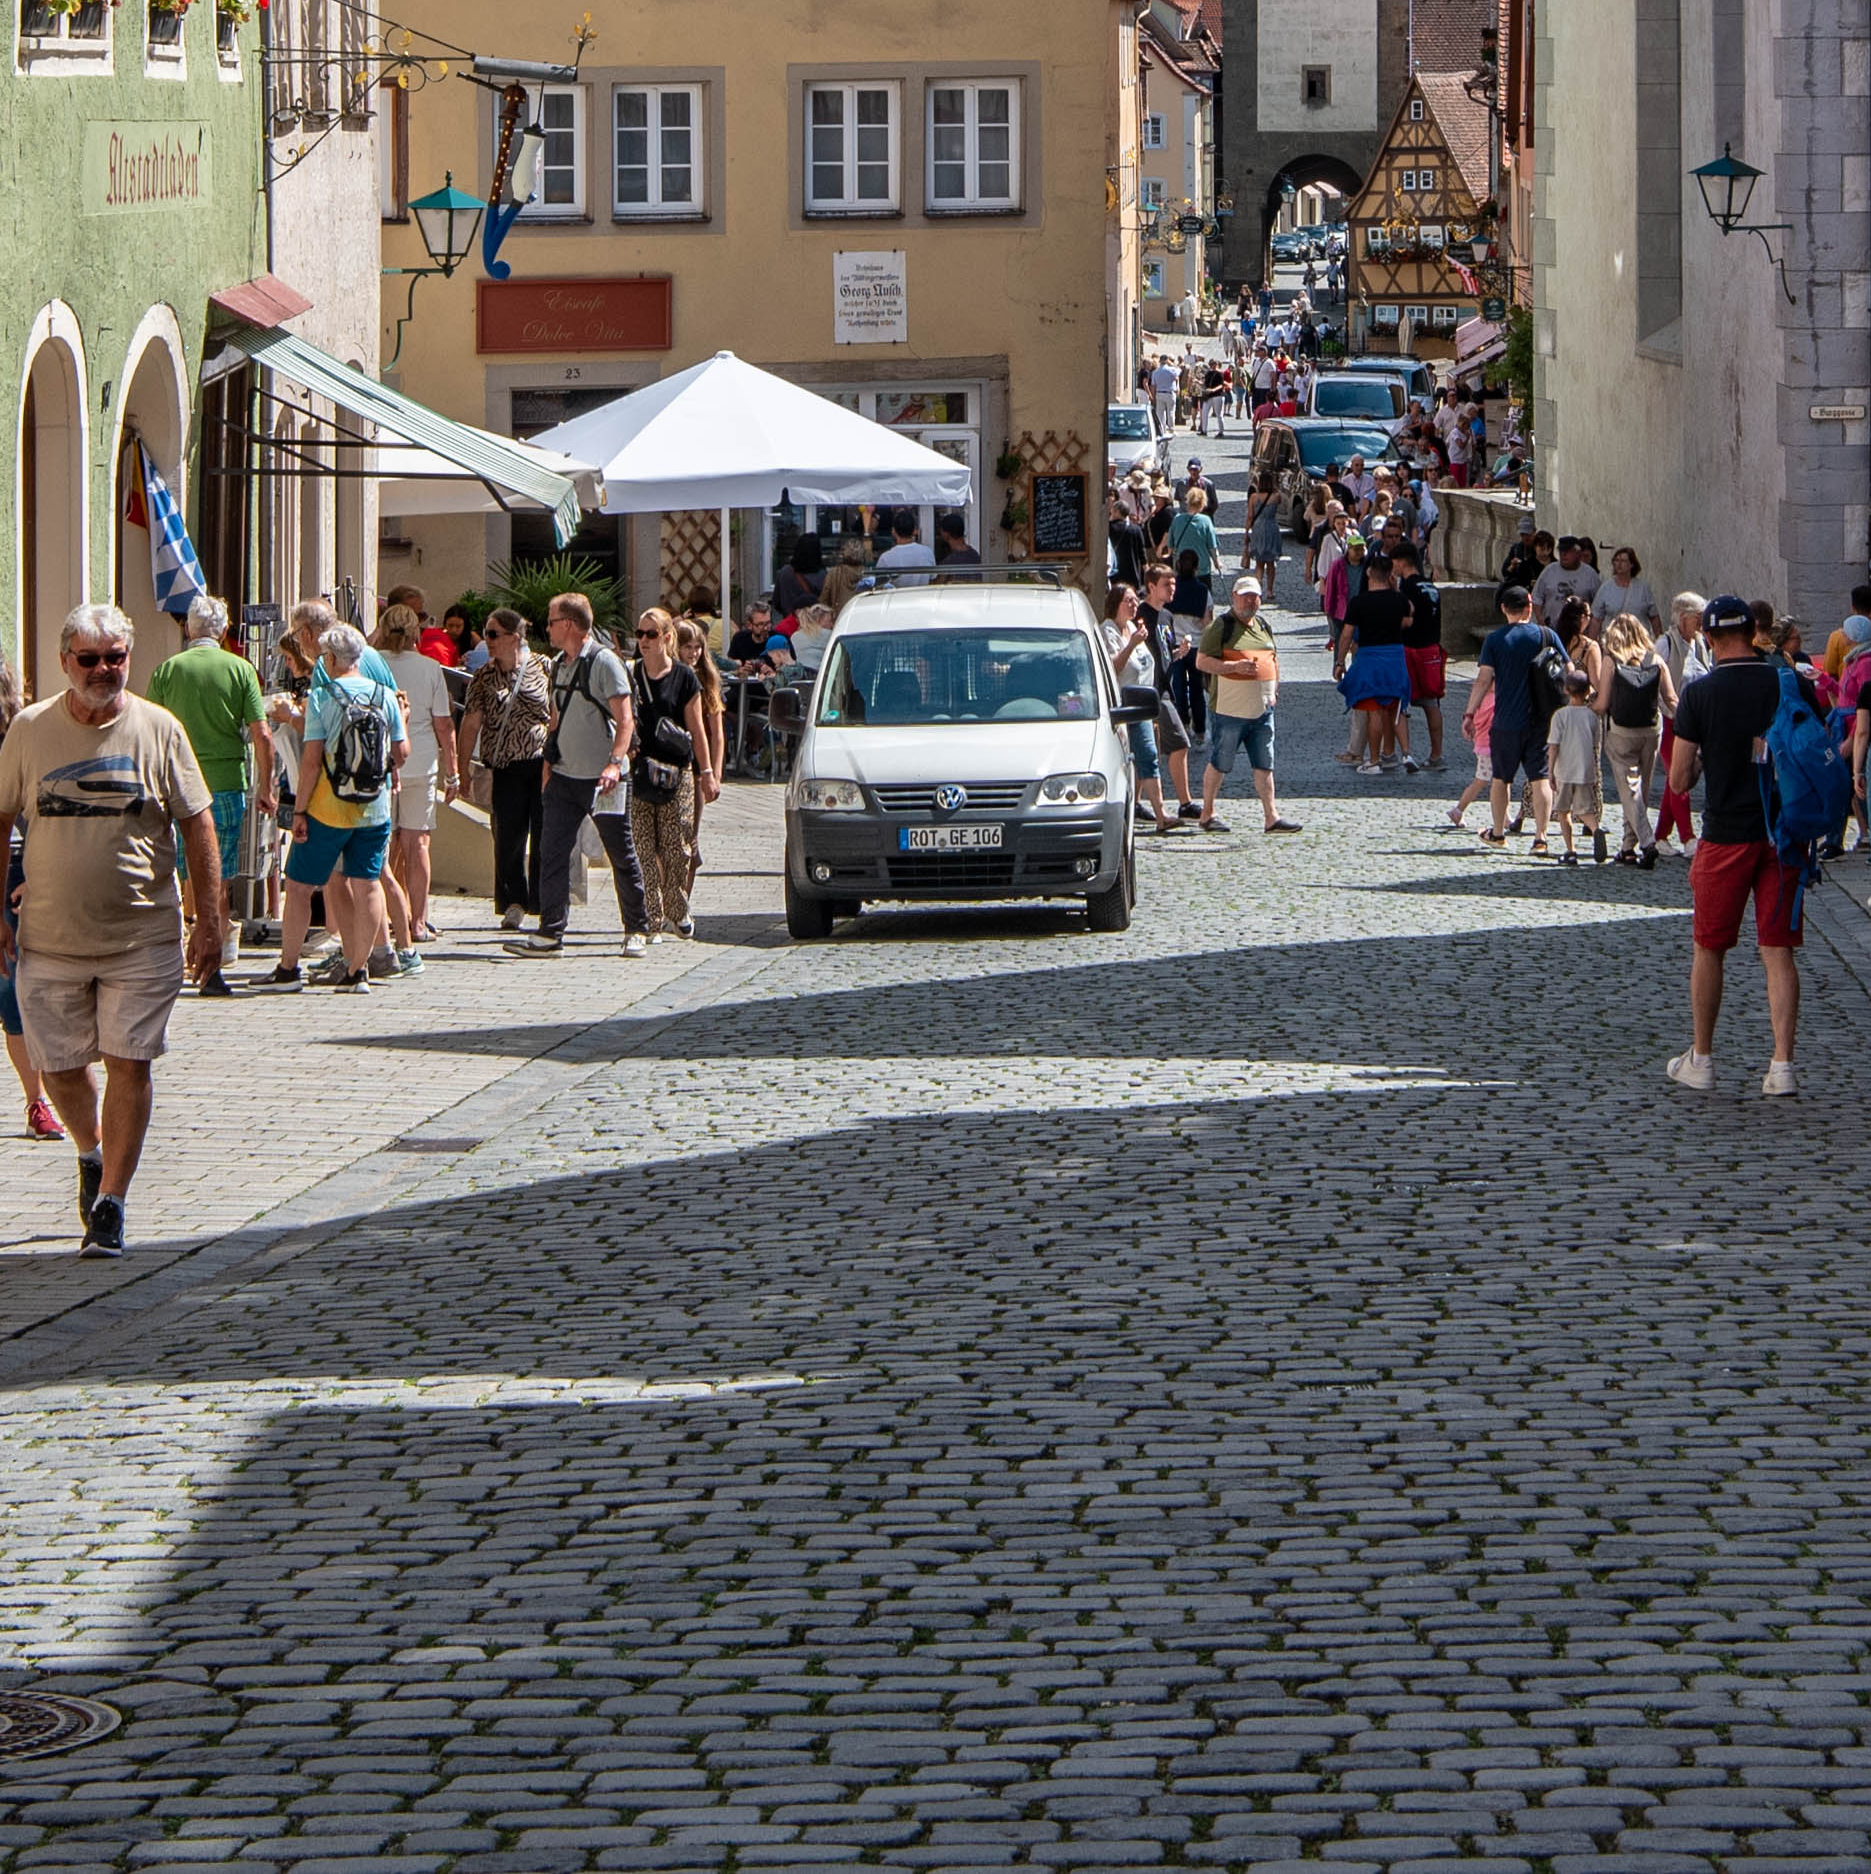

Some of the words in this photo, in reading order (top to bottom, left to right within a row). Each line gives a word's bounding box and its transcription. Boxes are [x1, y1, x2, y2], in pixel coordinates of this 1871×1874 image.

[106, 130, 200, 206] Altstadtladen
[839, 284, 871, 299] Georg
[521, 319, 574, 343] Dolce
[584, 320, 626, 342] Vita
[565, 368, 581, 380] 23
[909, 828, 938, 847] ROT
[949, 828, 970, 846] GE
[971, 827, 1001, 846] 106
